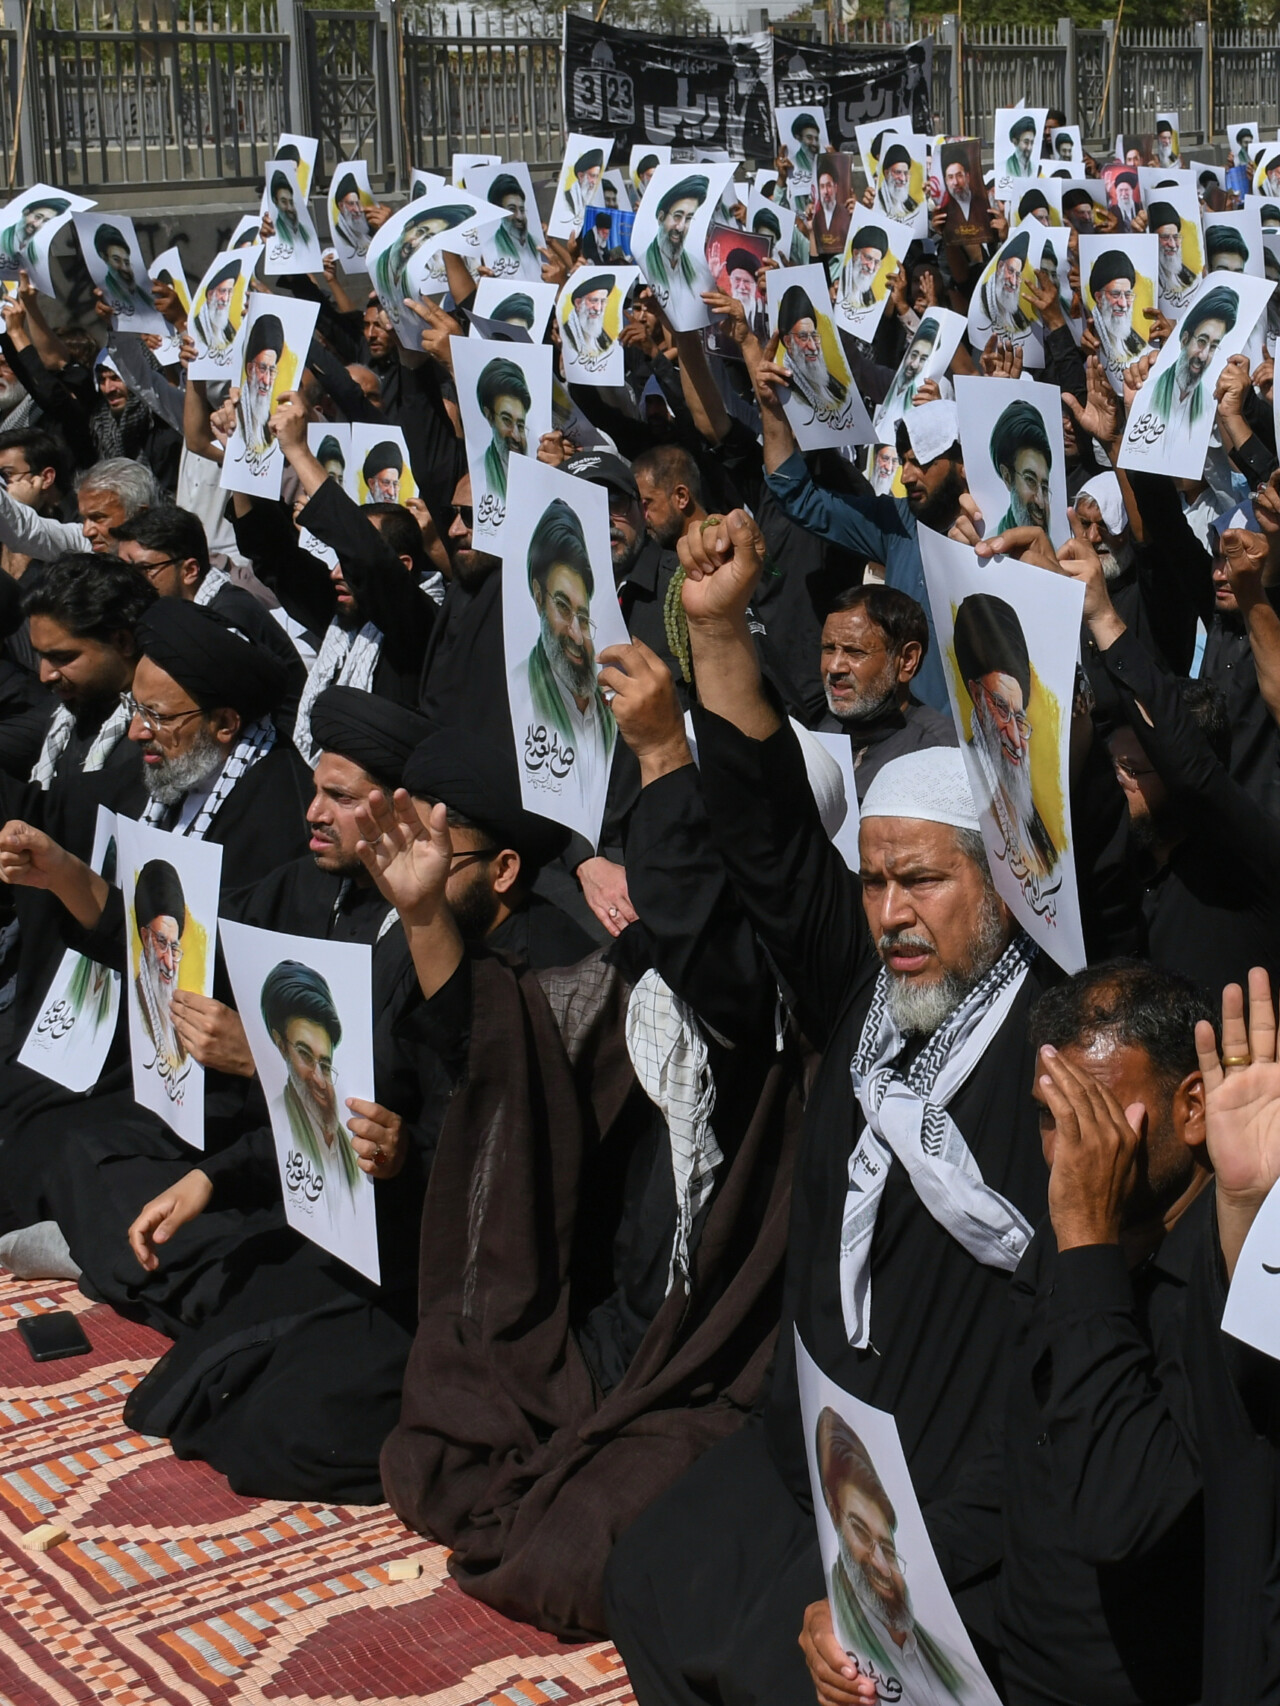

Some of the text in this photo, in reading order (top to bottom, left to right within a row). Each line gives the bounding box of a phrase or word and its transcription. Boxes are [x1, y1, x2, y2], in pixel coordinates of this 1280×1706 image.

[580, 75, 632, 109] 3 23
[1129, 414, 1165, 444] صالح بعد صالح
[568, 457, 601, 469] Reebok
[477, 494, 494, 523] صالح
[480, 506, 494, 521] بعد
[524, 723, 575, 778] صالح بعد صالح
[37, 1000, 66, 1033] صالح
[51, 1006, 75, 1039] صالح
[286, 1150, 324, 1202] صالح بعد صالح
